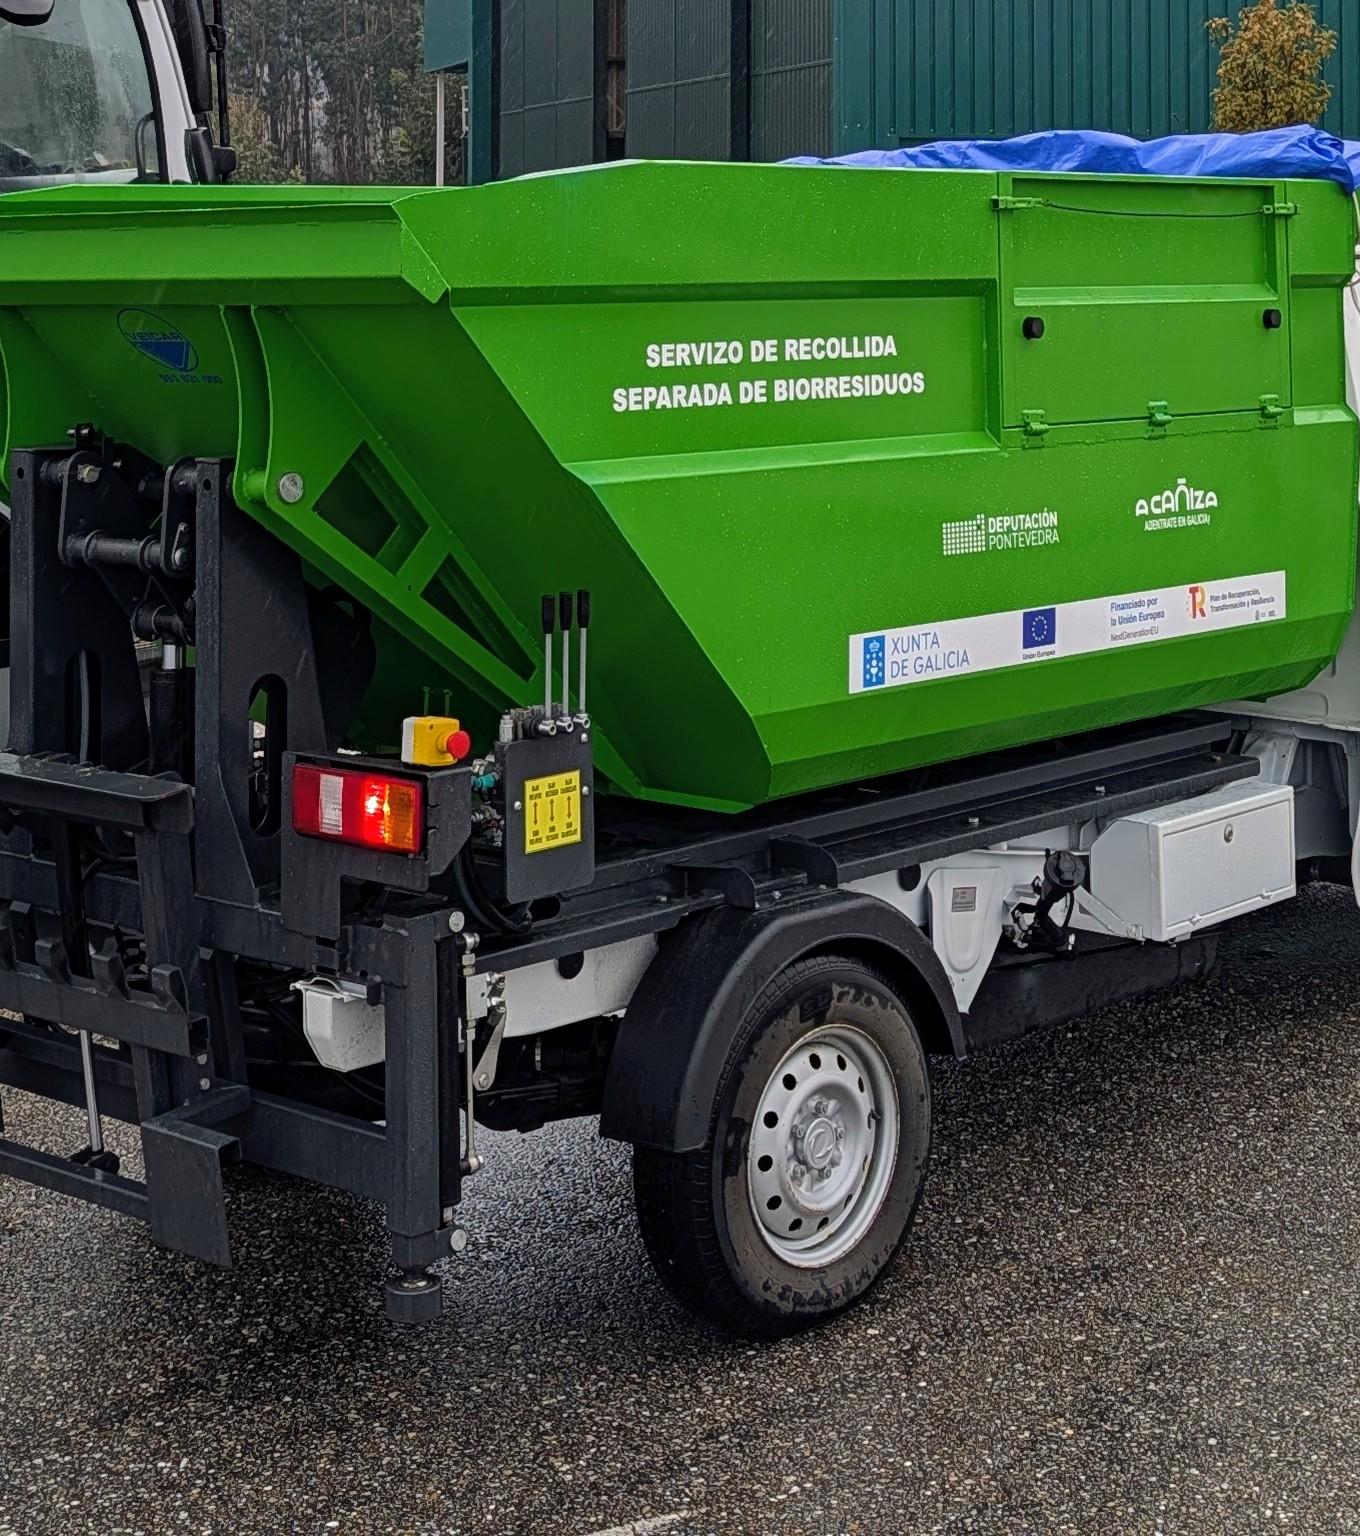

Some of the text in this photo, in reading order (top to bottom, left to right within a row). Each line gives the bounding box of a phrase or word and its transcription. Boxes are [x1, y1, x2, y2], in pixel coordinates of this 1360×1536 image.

[646, 335, 897, 368] SERVIZO DE RECOLLIDA
[612, 372, 925, 412] SEPARADA DE BIORRESIDUOS
[988, 507, 1058, 533] DEPUTACIÓN
[989, 528, 1060, 550] PONTEVEDRA
[1111, 597, 1158, 612] Financiado por
[1111, 617, 1117, 626] la
[1139, 610, 1165, 621] Europea
[891, 631, 940, 656] XUNTA
[1111, 625, 1159, 641] NextGenerationEU
[891, 649, 970, 678] DE GALICIA
